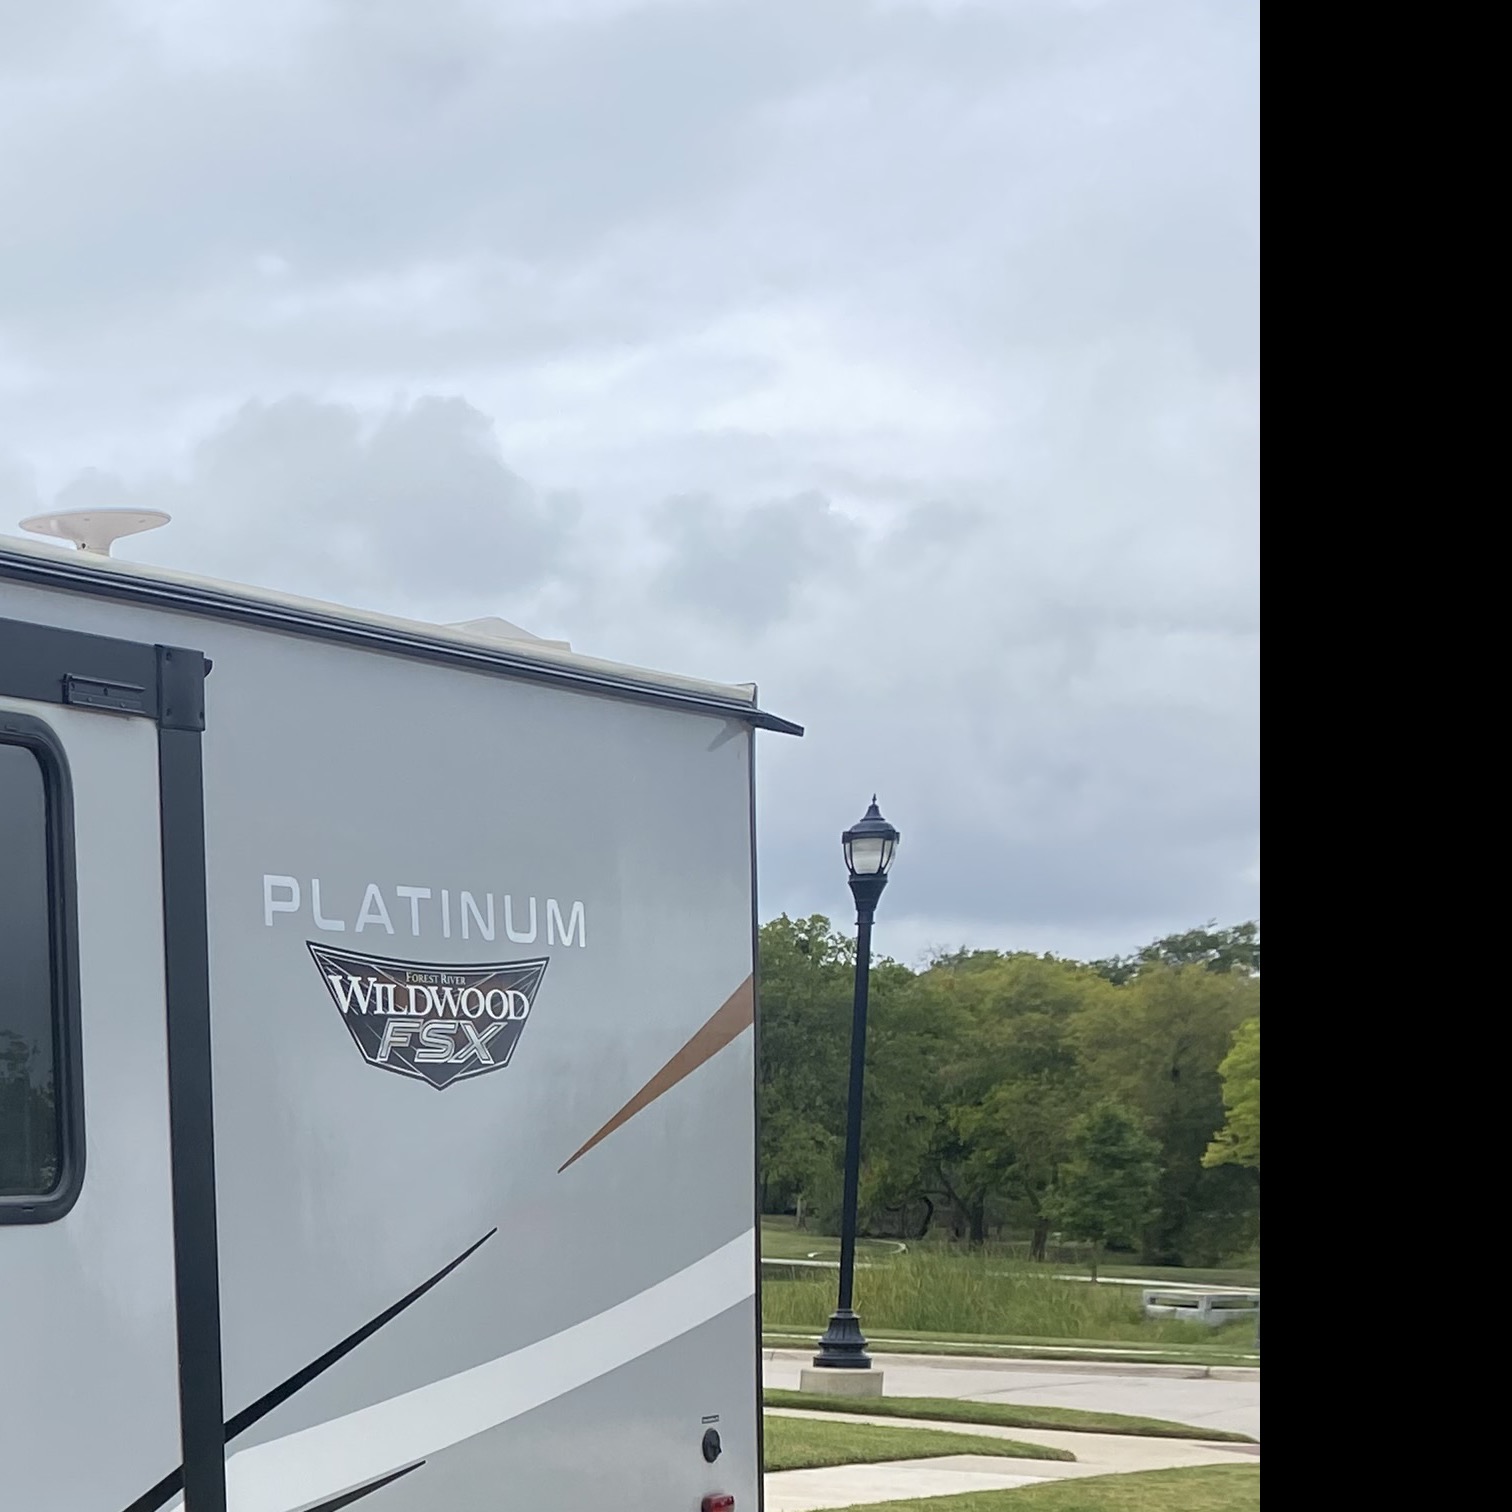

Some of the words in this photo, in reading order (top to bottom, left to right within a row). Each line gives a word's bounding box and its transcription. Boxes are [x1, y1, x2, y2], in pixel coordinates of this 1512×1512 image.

[263, 874, 586, 948] PLATINUM
[328, 975, 530, 1020] WILDWOOD
[406, 971, 439, 984] FOREST
[440, 973, 466, 985] RIVER
[377, 1017, 508, 1065] FSX
